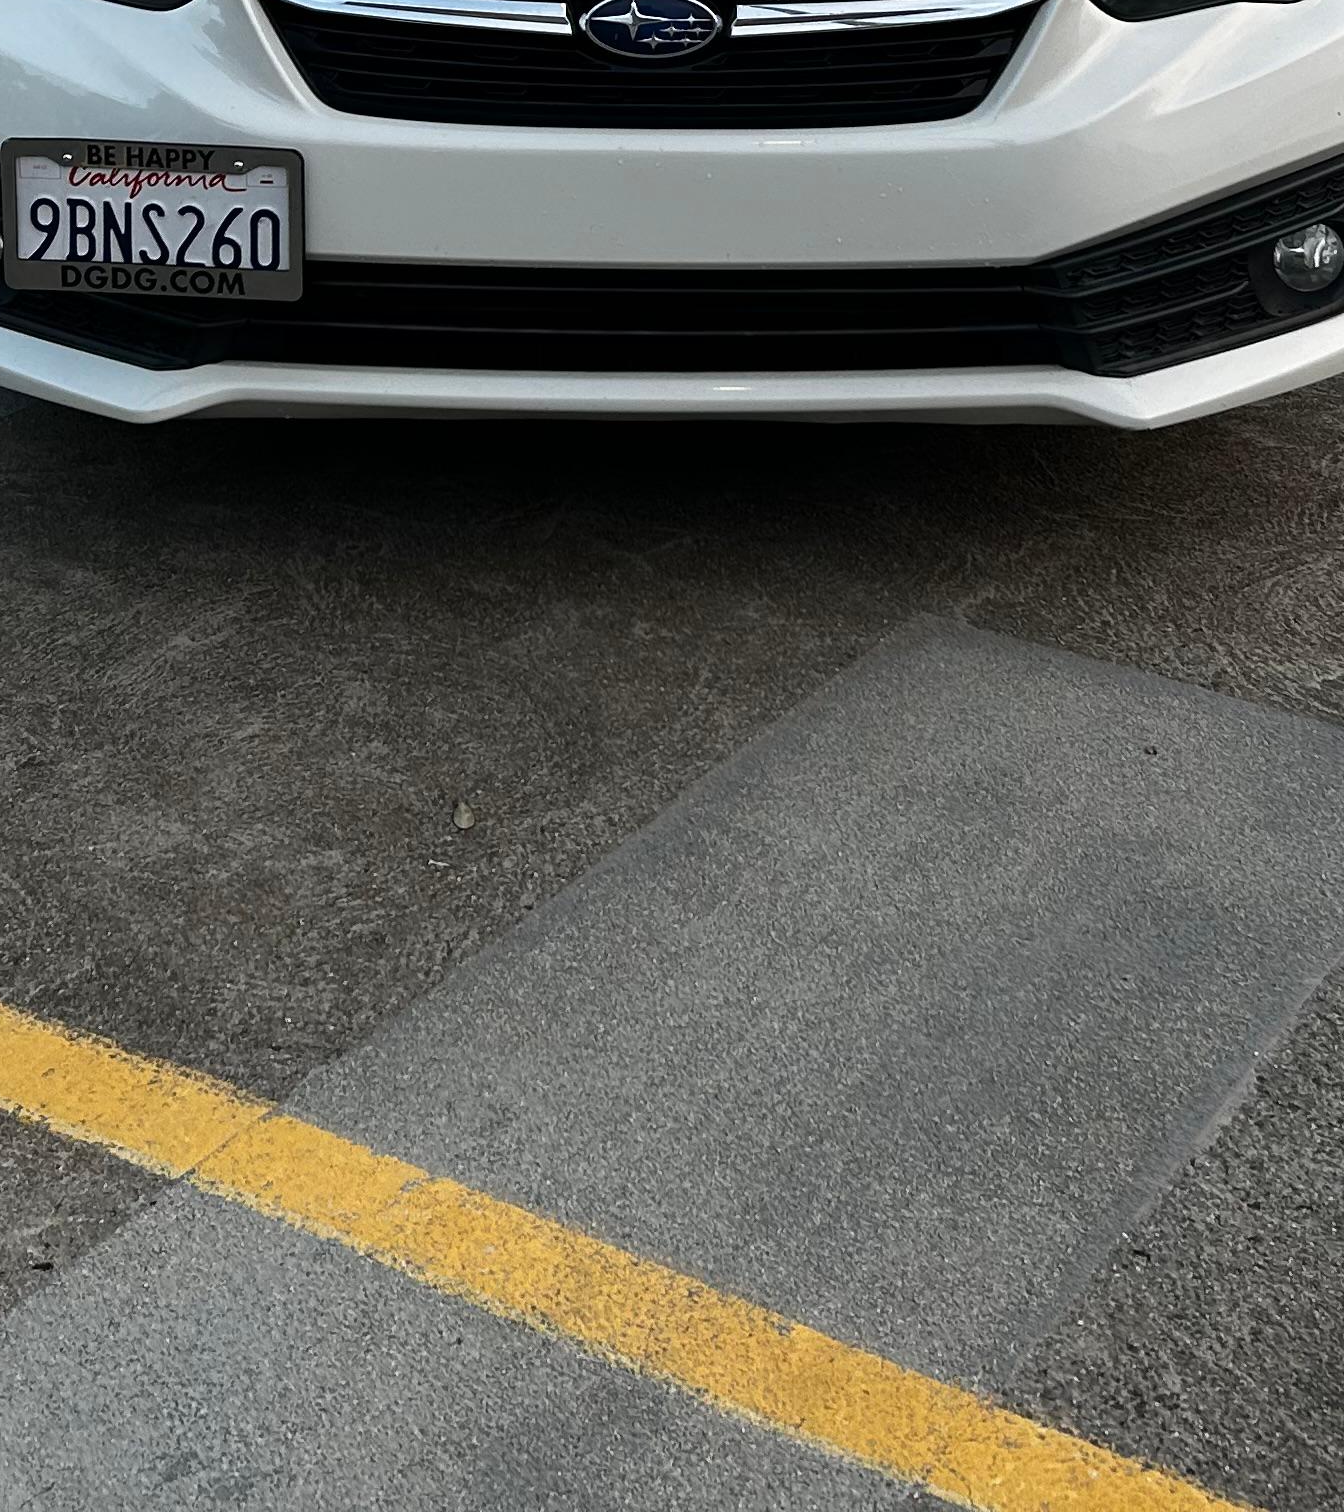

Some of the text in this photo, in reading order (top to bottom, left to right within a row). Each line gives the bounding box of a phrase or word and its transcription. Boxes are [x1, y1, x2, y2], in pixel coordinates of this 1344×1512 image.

[87, 144, 216, 171] BE HAPPY
[68, 166, 247, 199] California
[28, 197, 281, 271] 9BNS260
[61, 265, 245, 295] DGDG.COM
